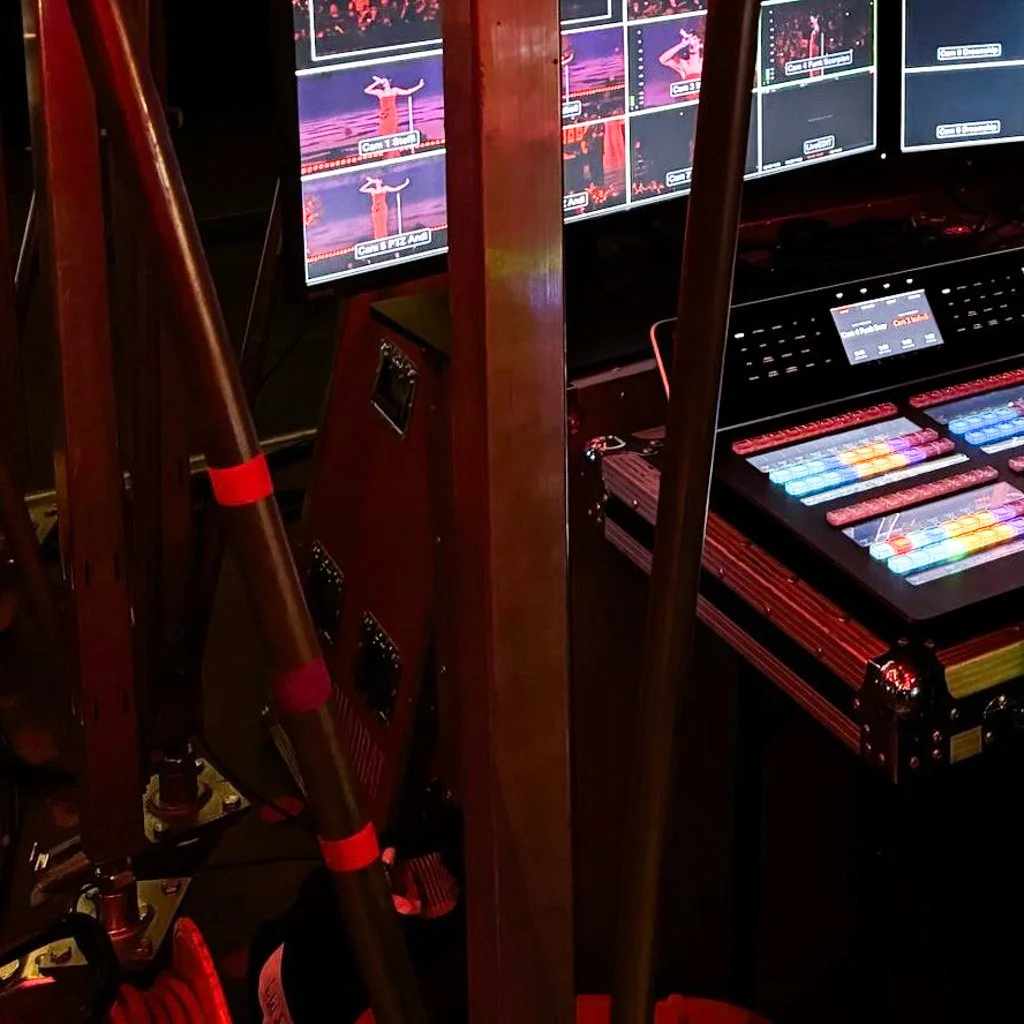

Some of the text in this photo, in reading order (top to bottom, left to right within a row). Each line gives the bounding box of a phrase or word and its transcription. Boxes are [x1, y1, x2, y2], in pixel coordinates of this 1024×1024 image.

[362, 141, 384, 153] Cam
[359, 244, 379, 256] Cam
[388, 236, 407, 249] PTZ
